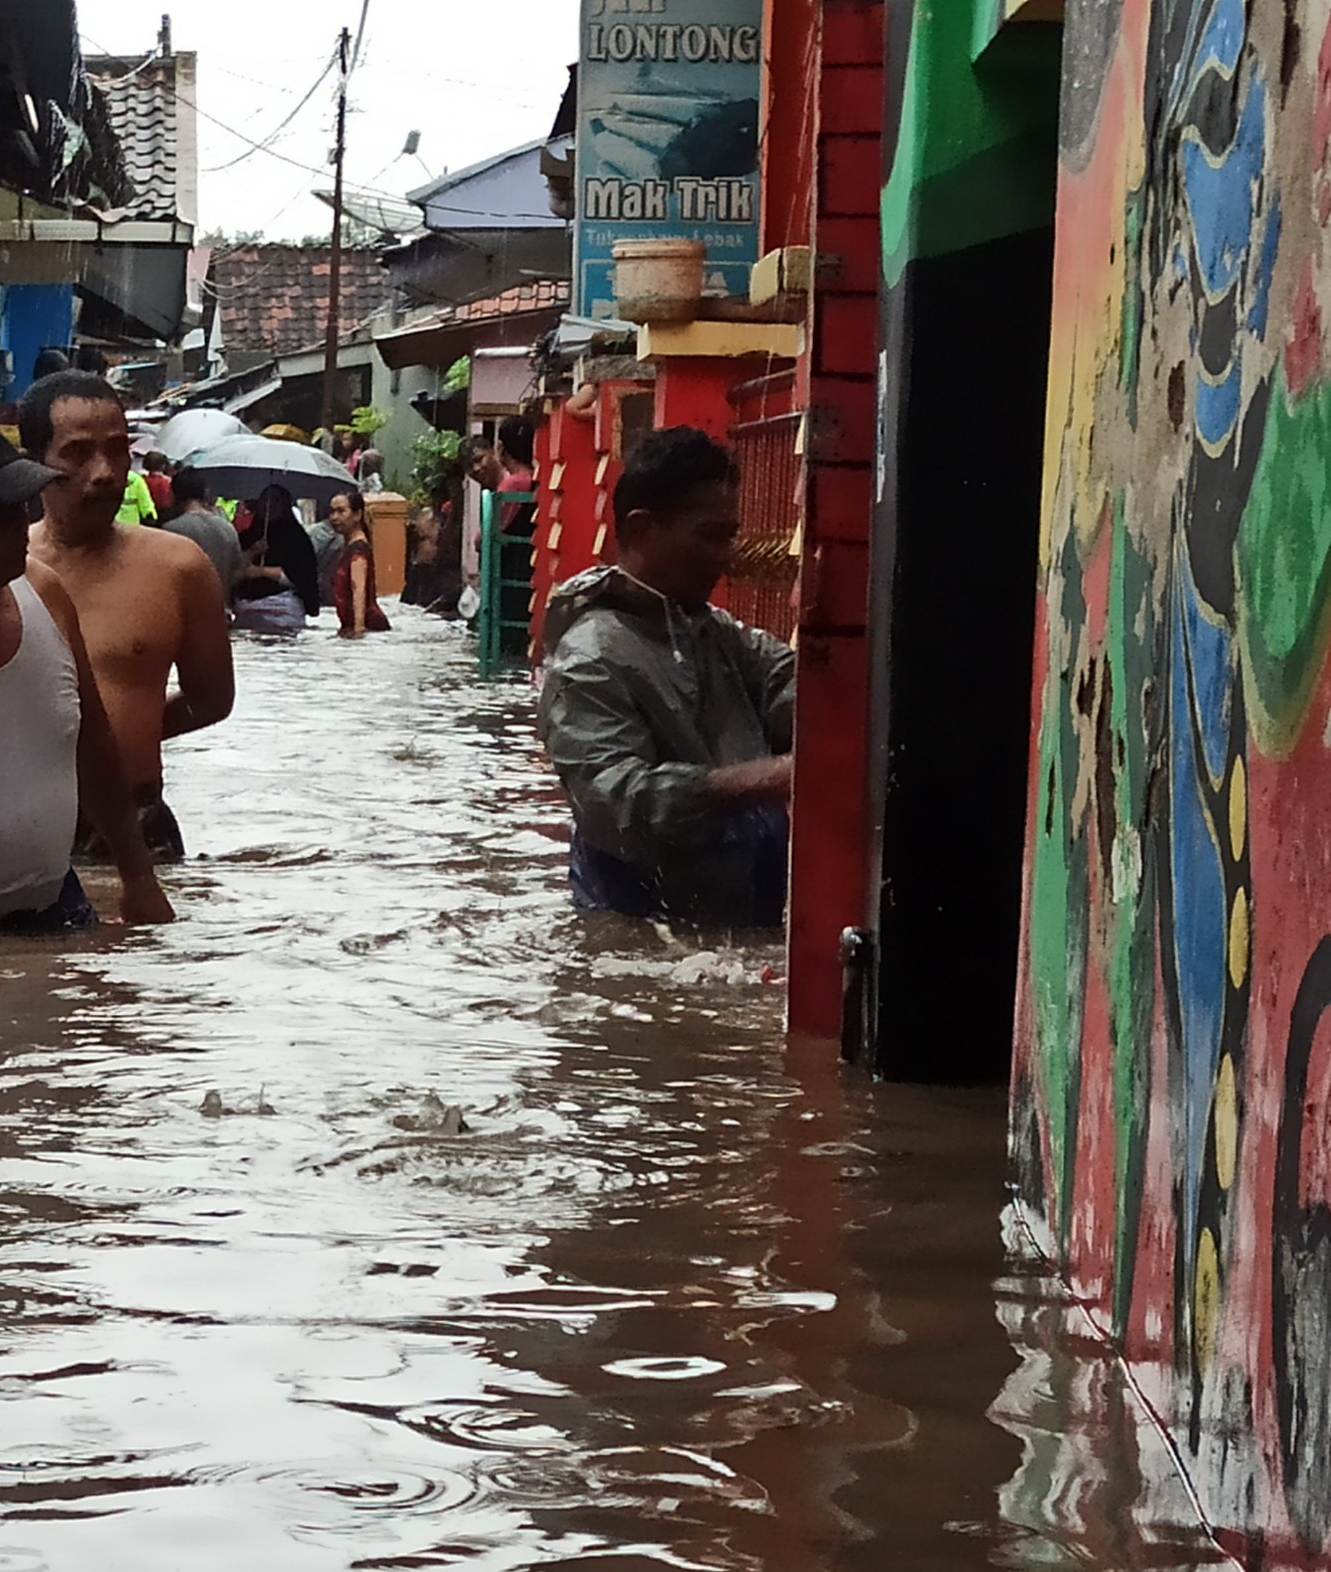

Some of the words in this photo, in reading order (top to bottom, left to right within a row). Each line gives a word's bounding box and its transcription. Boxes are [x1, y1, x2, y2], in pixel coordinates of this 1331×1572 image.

[588, 24, 759, 62] LONTONG
[585, 178, 667, 220] Mak
[676, 178, 753, 222] Trik
